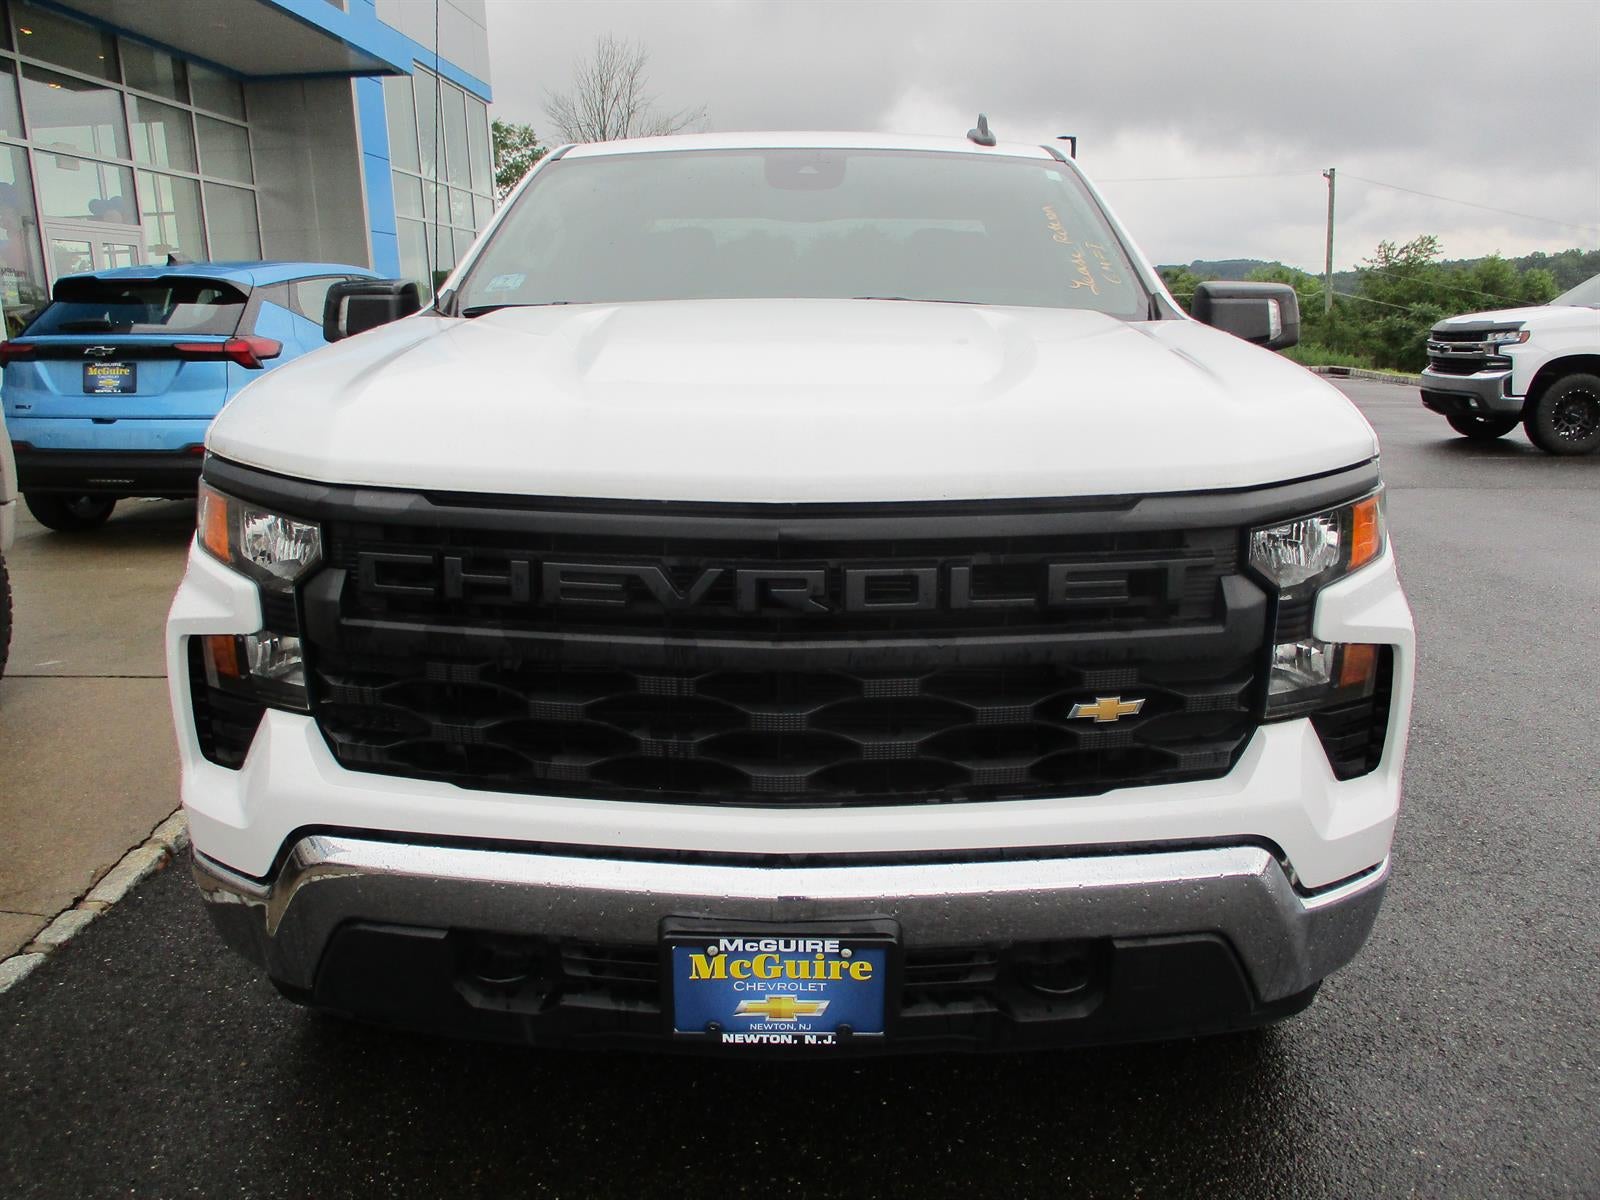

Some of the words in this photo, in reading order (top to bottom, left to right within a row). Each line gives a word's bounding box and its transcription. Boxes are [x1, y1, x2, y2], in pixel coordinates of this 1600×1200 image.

[88, 367, 130, 375] McGuire
[357, 551, 1216, 612] CHEVROLET
[719, 939, 840, 953] McGUIRE
[689, 953, 873, 981] McGuire
[733, 981, 827, 992] CHEVROLET
[749, 1023, 796, 1031] NEWTON,
[722, 1034, 798, 1045] NEWTON,
[804, 1035, 837, 1045] N.J.
